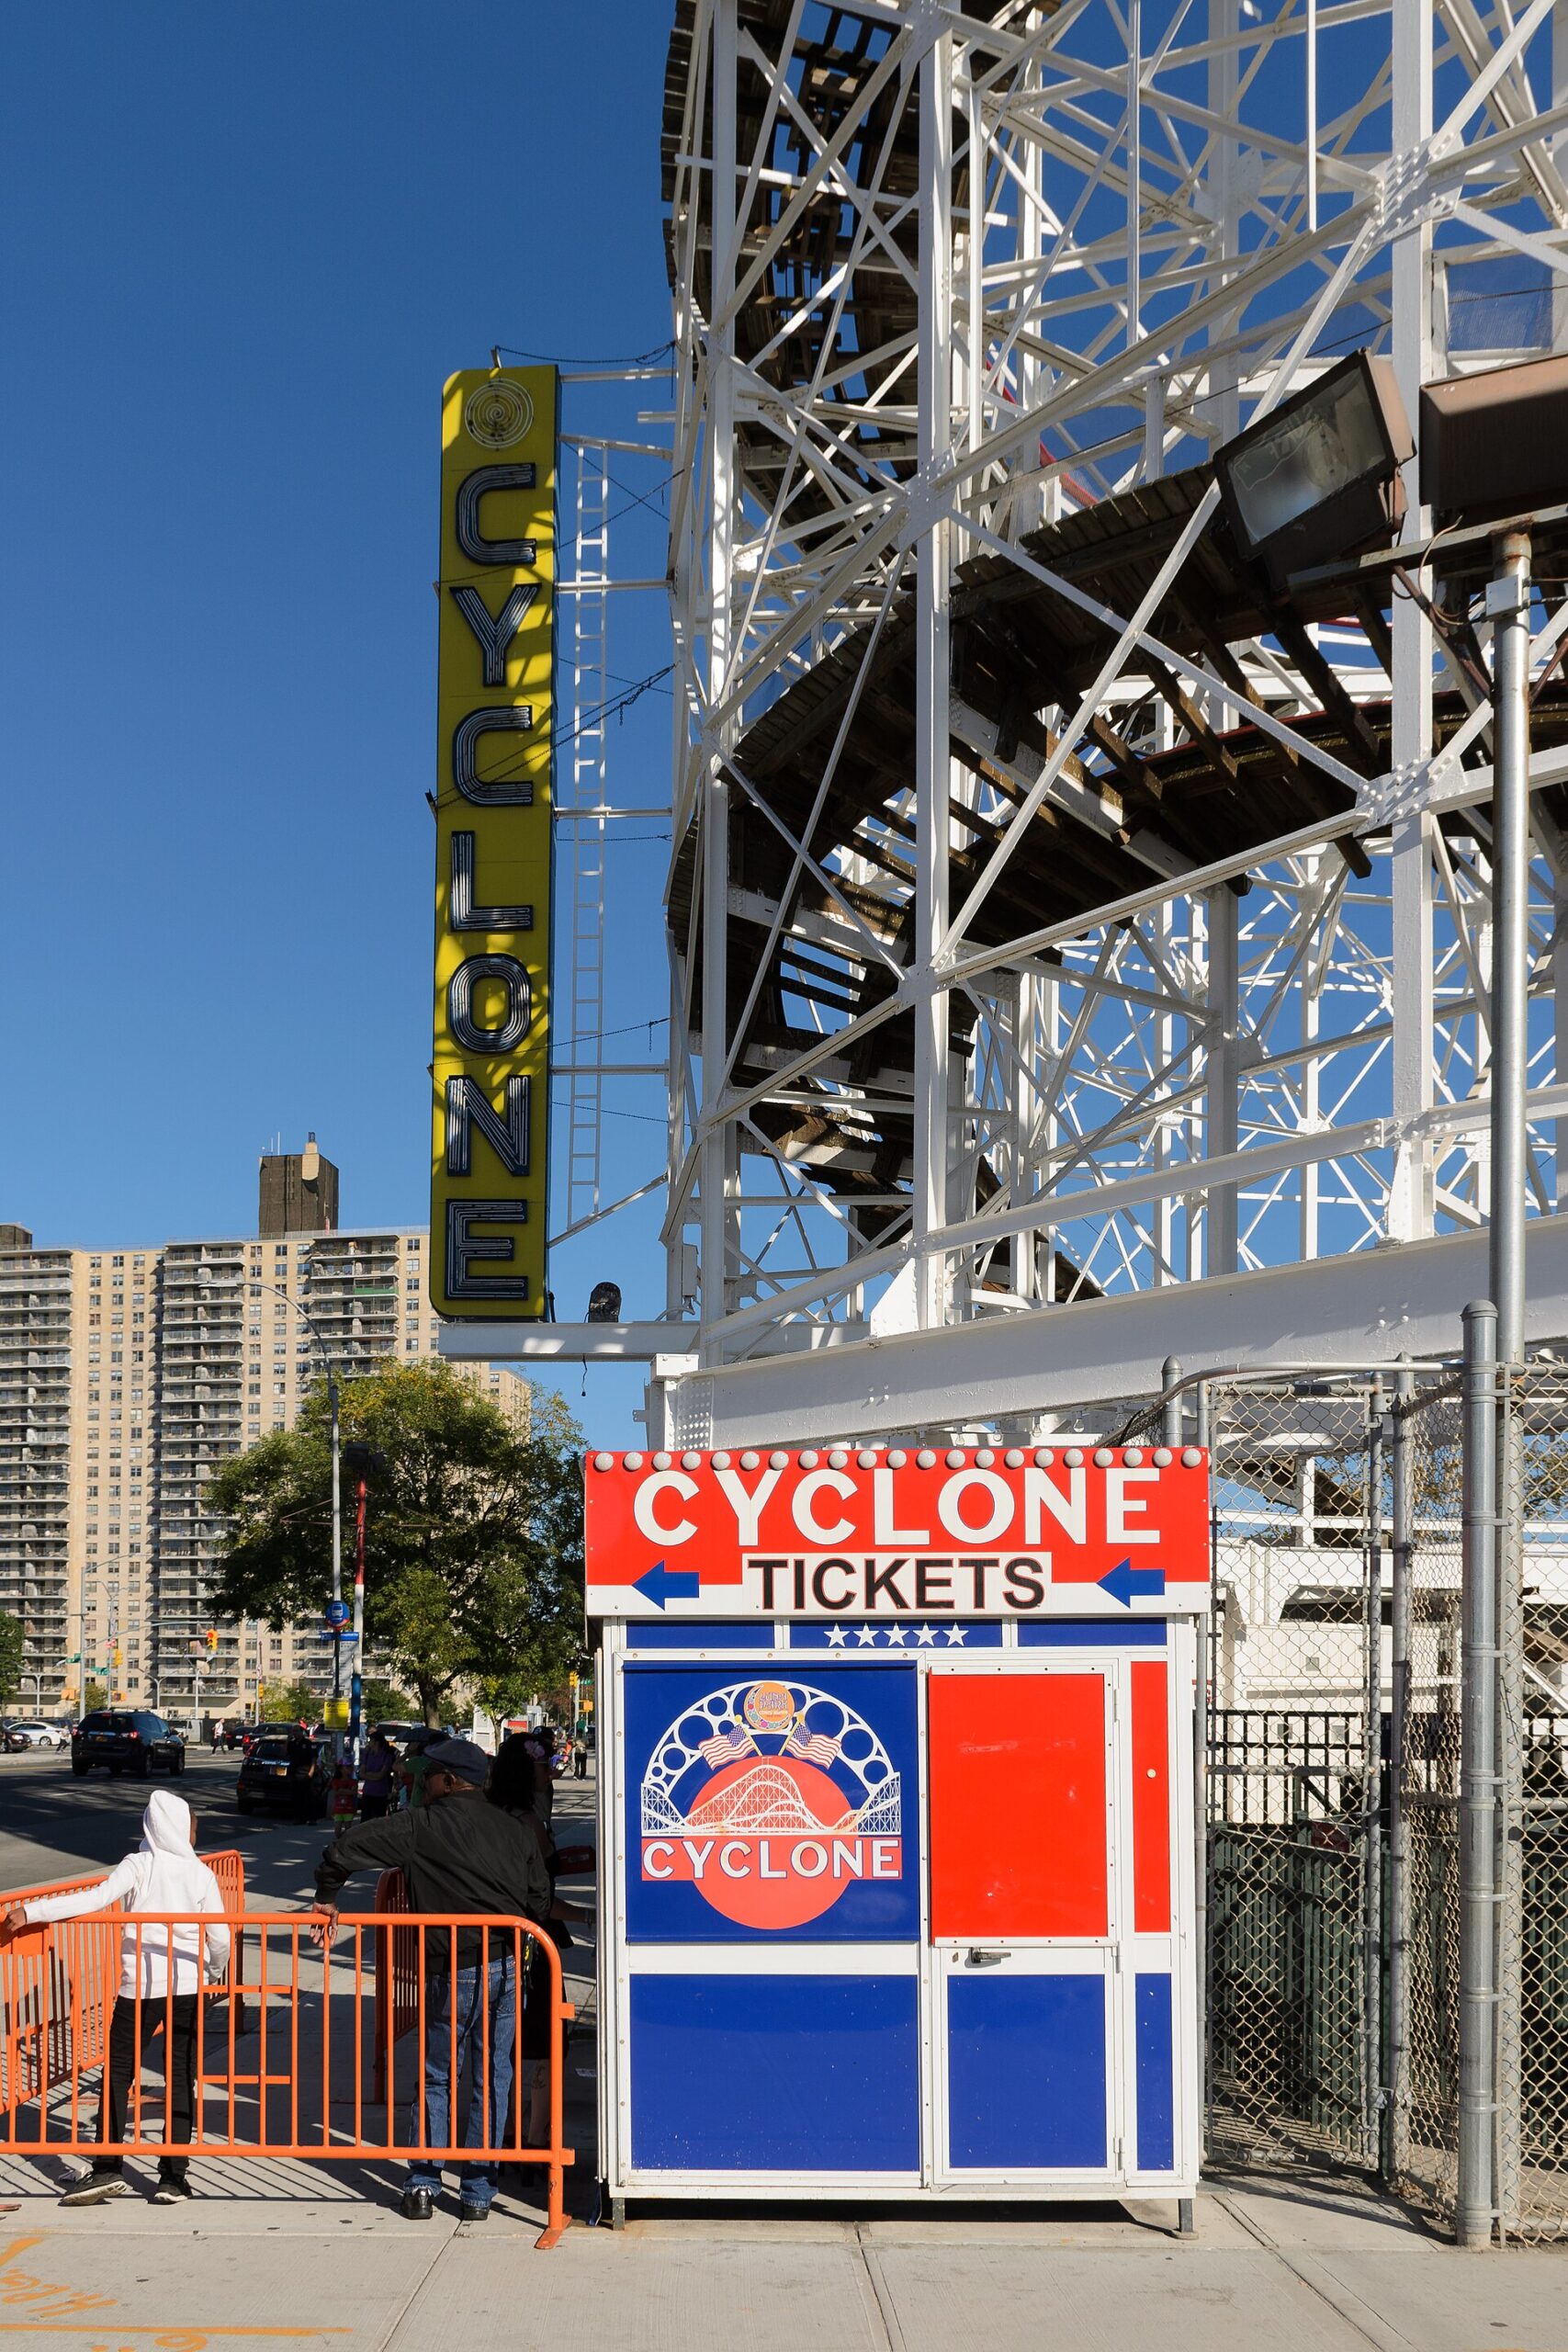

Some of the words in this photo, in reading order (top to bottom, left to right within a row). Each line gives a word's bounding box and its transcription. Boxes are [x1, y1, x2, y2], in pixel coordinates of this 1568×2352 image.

[445, 462, 543, 1301] CYCLONE
[633, 1467, 1161, 1546] CYCLONE
[747, 1557, 1045, 1611] TICKETS
[642, 1839, 901, 1879] CYCLONE
